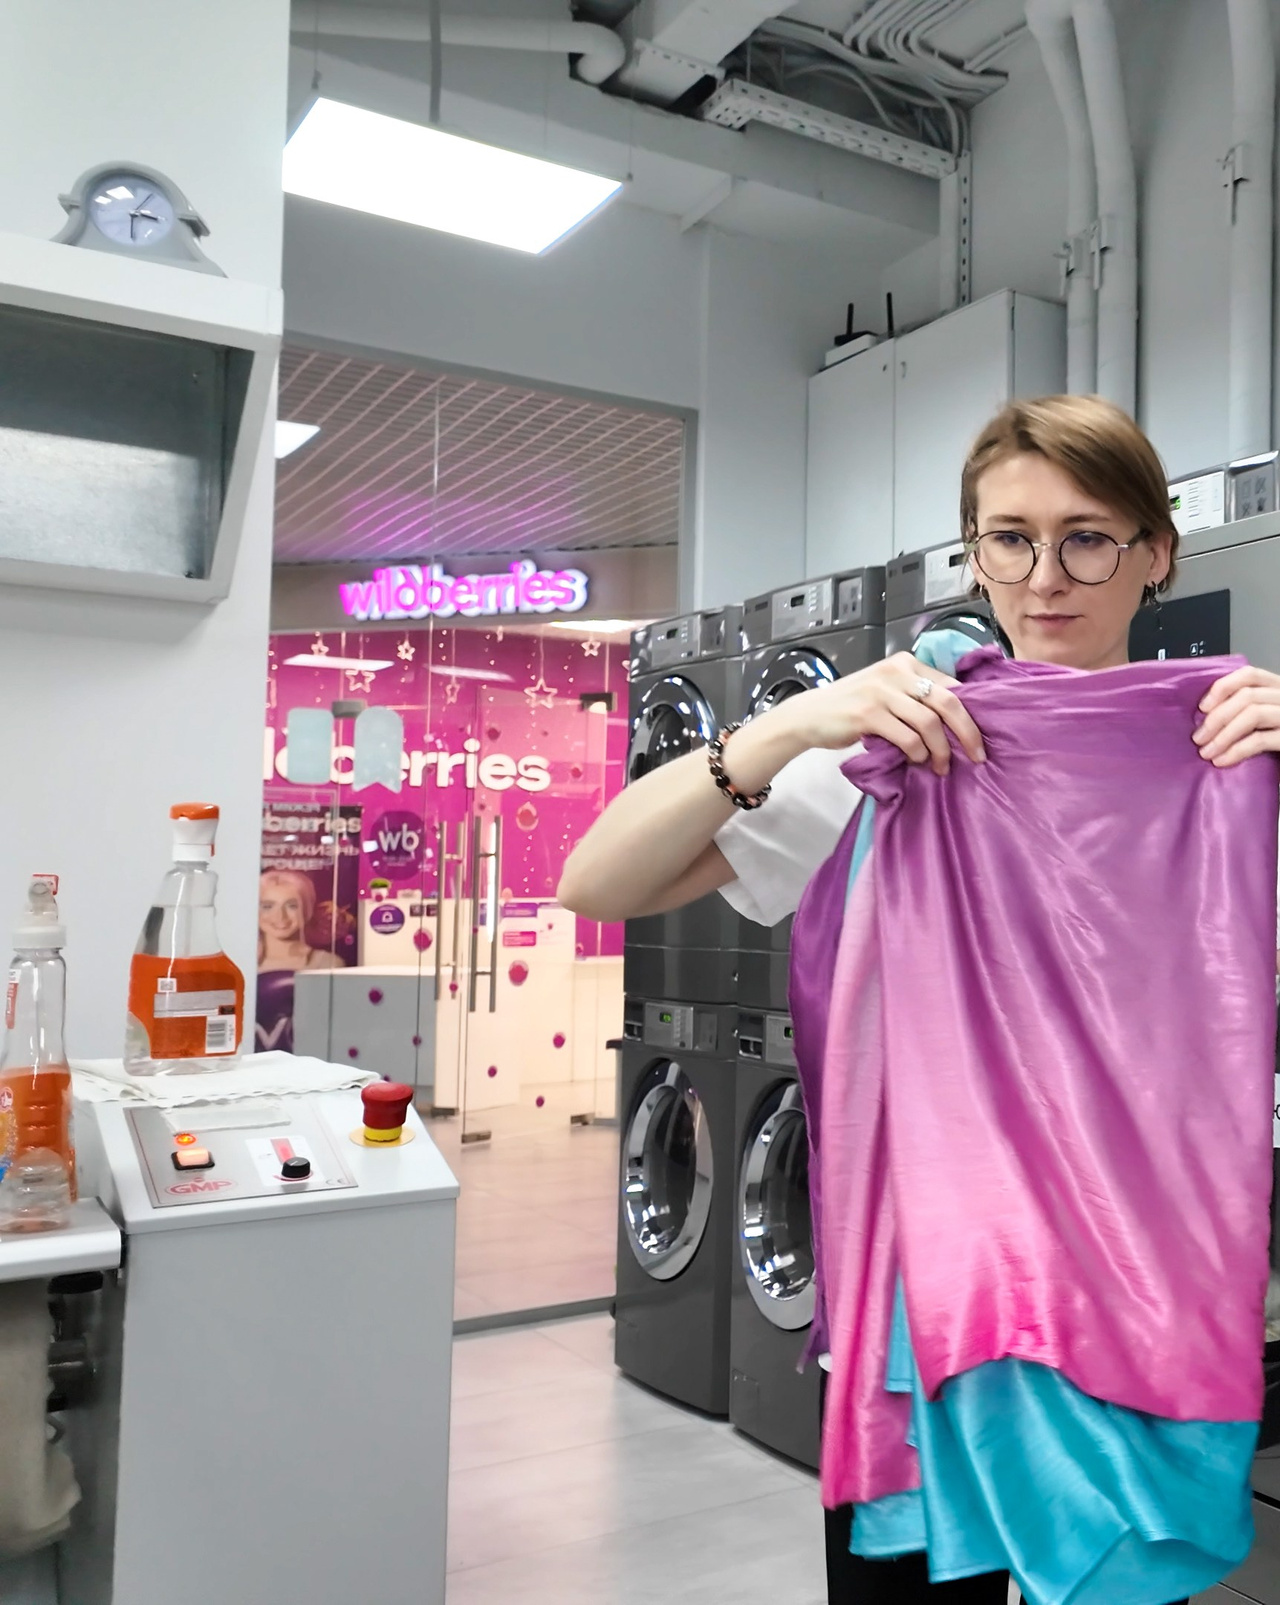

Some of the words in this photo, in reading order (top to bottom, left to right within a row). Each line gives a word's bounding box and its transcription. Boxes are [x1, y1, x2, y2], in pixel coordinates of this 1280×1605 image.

[339, 559, 588, 622] wildberries
[378, 822, 420, 853] wb
[169, 1180, 232, 1195] GMP
